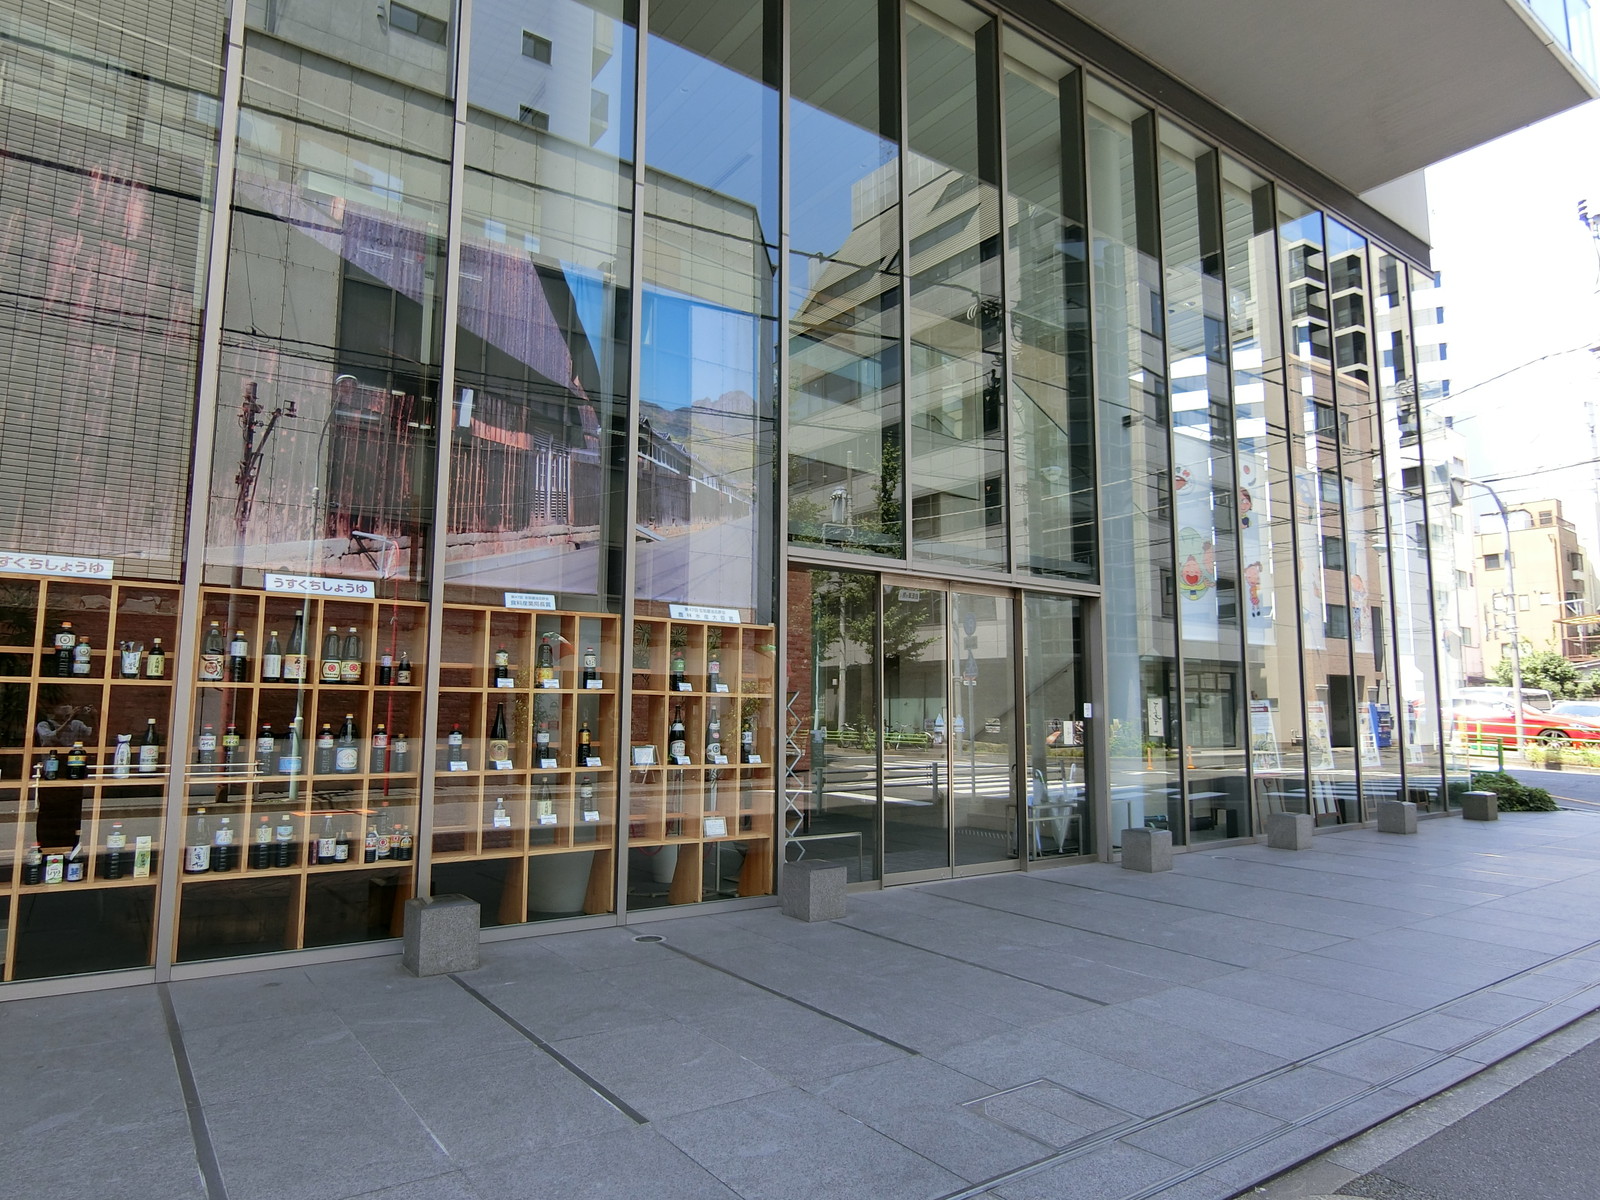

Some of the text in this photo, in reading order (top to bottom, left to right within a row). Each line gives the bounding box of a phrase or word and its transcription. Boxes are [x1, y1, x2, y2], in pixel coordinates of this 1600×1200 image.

[273, 577, 368, 594] うすくちしょうゆ
